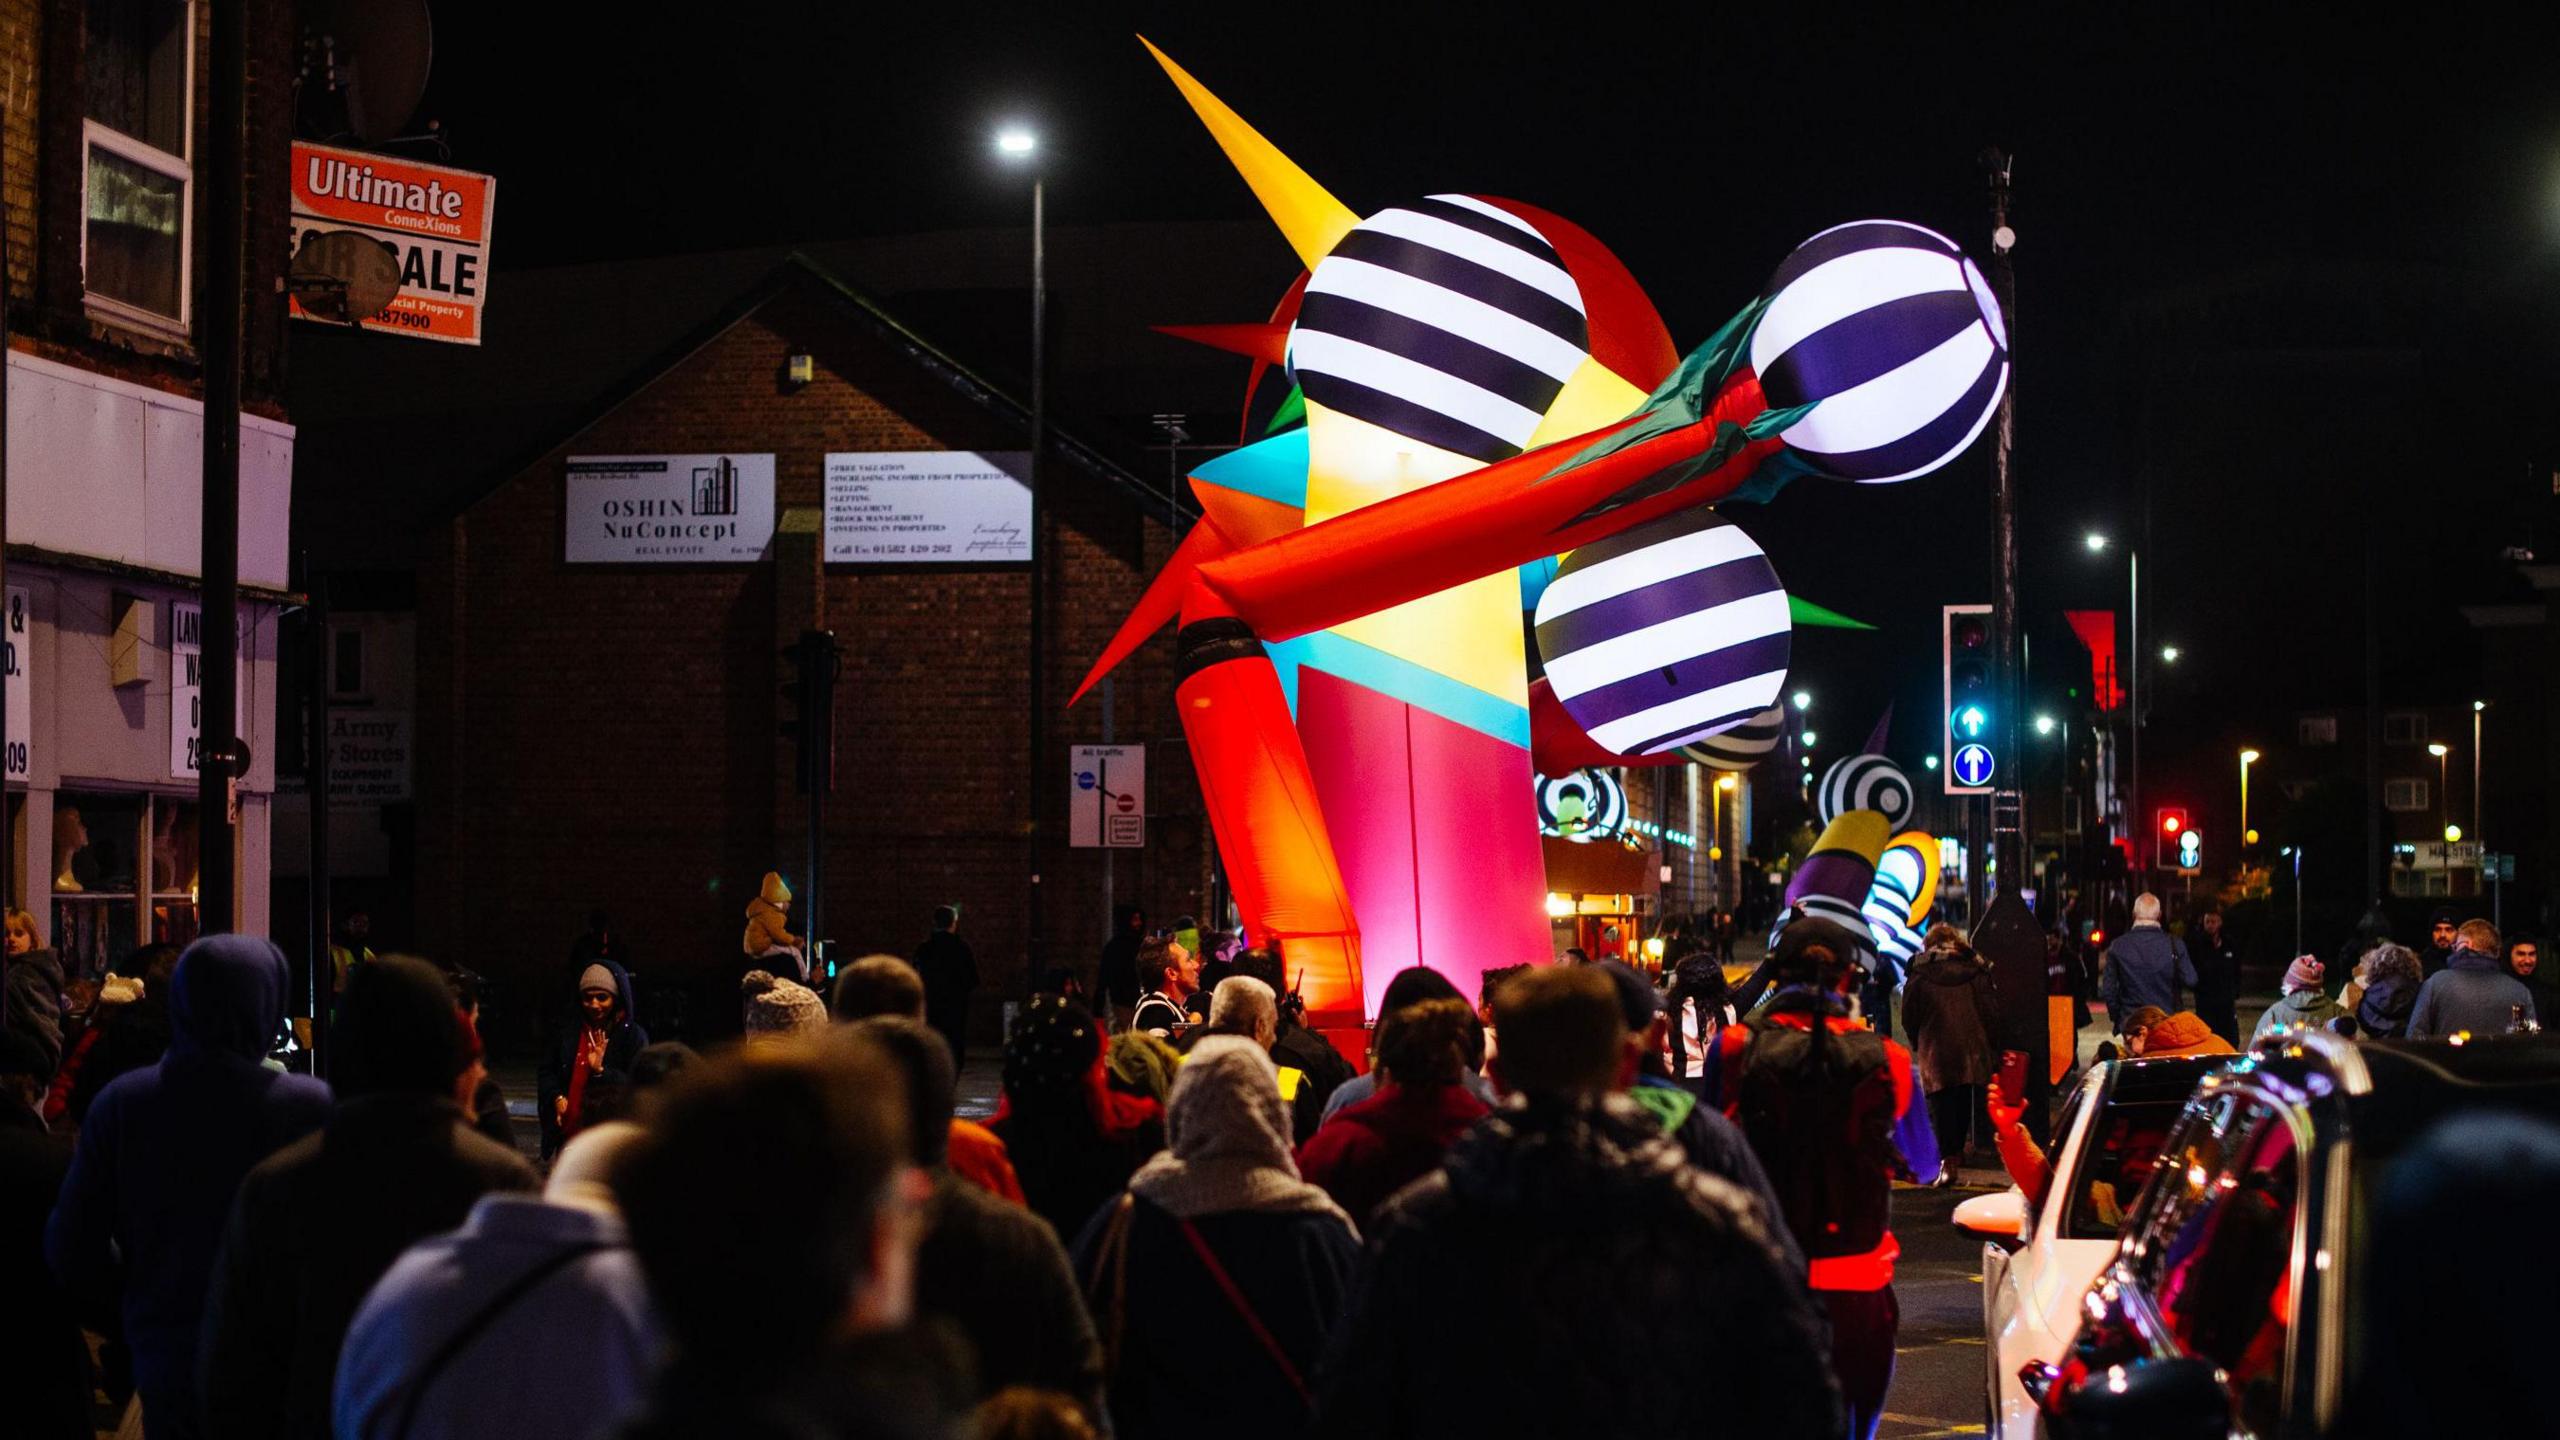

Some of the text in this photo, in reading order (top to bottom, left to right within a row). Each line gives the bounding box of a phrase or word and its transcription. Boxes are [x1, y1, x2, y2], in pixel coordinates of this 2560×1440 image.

[308, 156, 464, 219] Ultimate
[384, 209, 462, 235] ConneXions
[419, 302, 464, 319] Property
[834, 464, 857, 472] FREE
[834, 474, 884, 482] INCREASING
[887, 473, 925, 481] INCOMES
[927, 473, 952, 481] FROM
[603, 500, 685, 518] OSHIN
[834, 504, 893, 512] MANAGEMENT
[834, 514, 924, 523] BLOCK MANAGEMENT
[603, 521, 737, 541] NuConcept
[834, 524, 946, 532] INVESTING IN PROPERTIES
[635, 546, 705, 555] REAL ESTATE
[833, 545, 853, 554] Call
[872, 545, 905, 554] 01582
[910, 545, 930, 554] 420
[932, 544, 953, 554] 202
[11, 595, 24, 633] &
[332, 718, 398, 742] Army
[340, 744, 405, 763] Stores
[1082, 748, 1124, 756] All traffic
